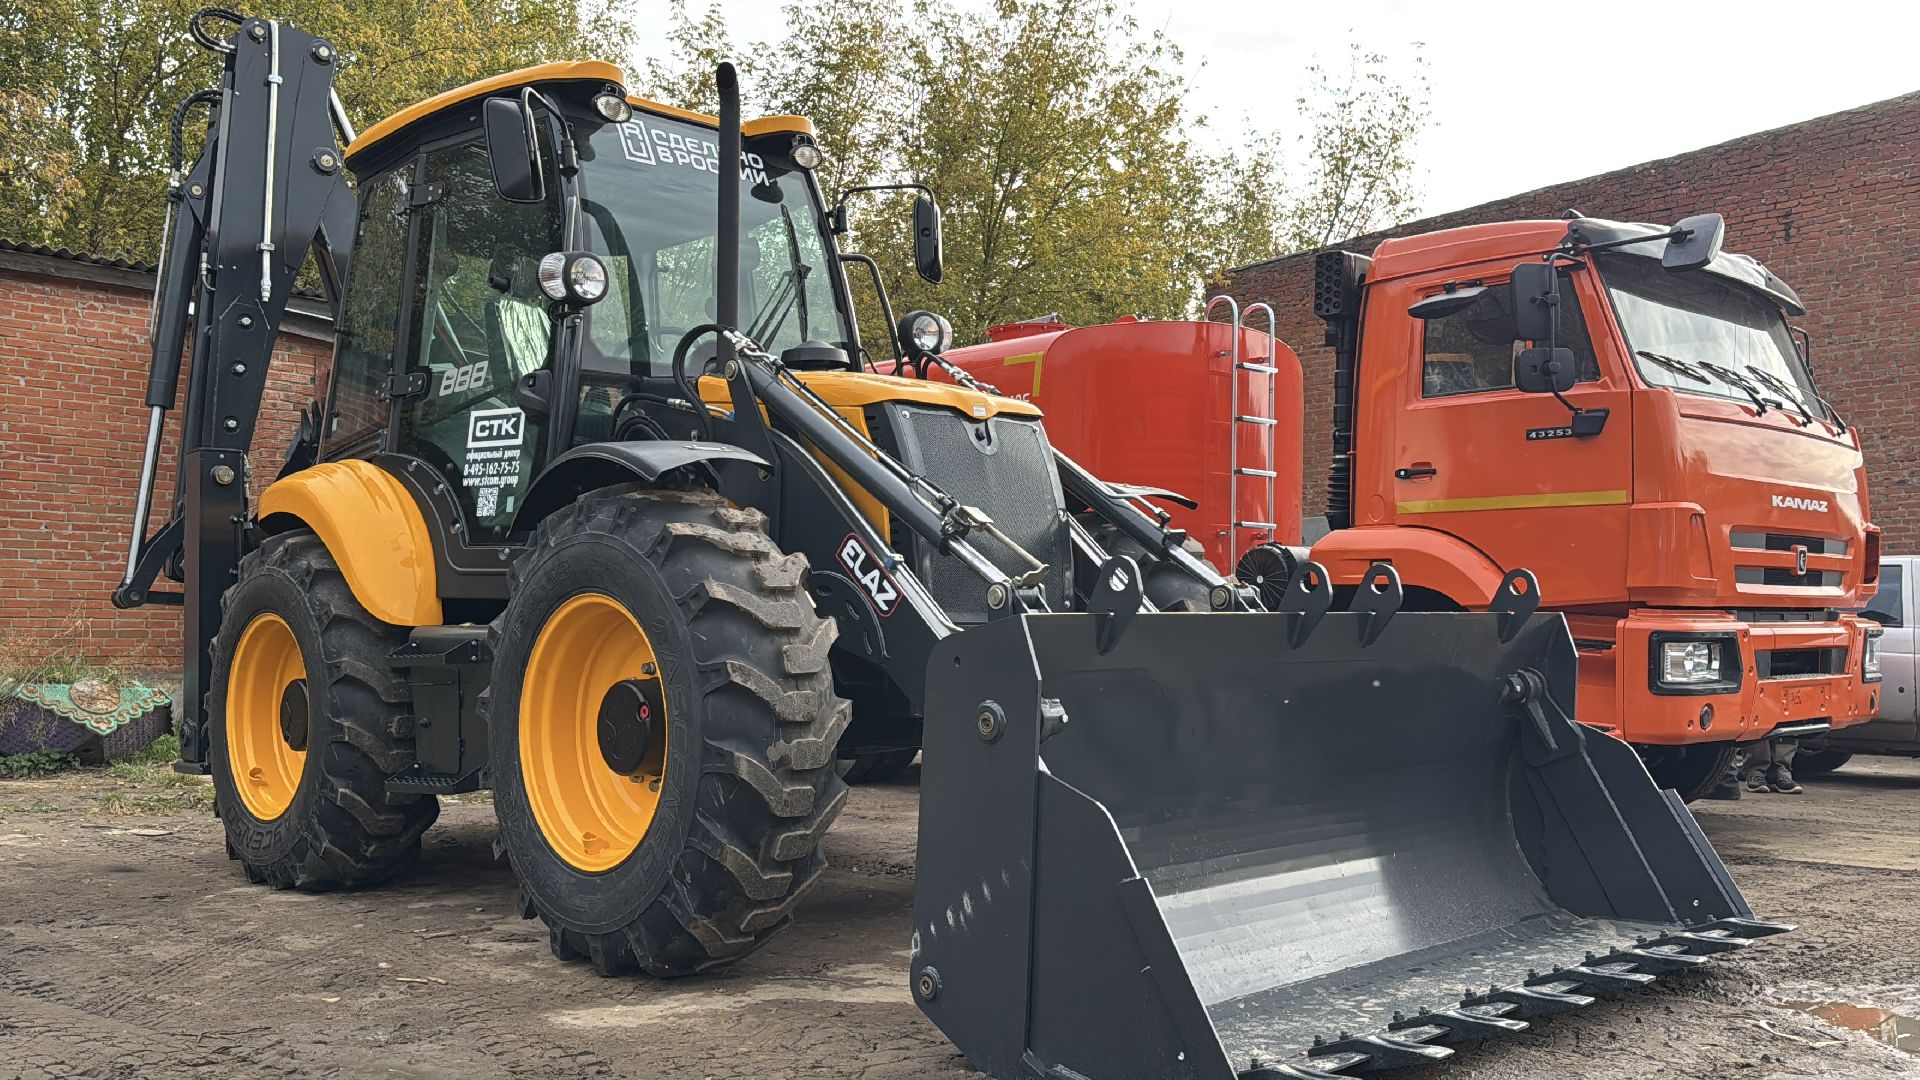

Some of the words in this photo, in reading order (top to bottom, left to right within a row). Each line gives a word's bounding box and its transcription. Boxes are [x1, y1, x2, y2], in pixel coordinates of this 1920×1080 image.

[650, 128, 764, 169] СДЕЛНО
[673, 150, 770, 187] РОСИИ
[439, 360, 489, 397] 888
[475, 417, 518, 437] СТК
[1529, 428, 1573, 440] 43253
[463, 460, 520, 476] 8-495-162-75-75
[1771, 494, 1829, 513] KAMAZ
[841, 539, 898, 611] ELAZ
